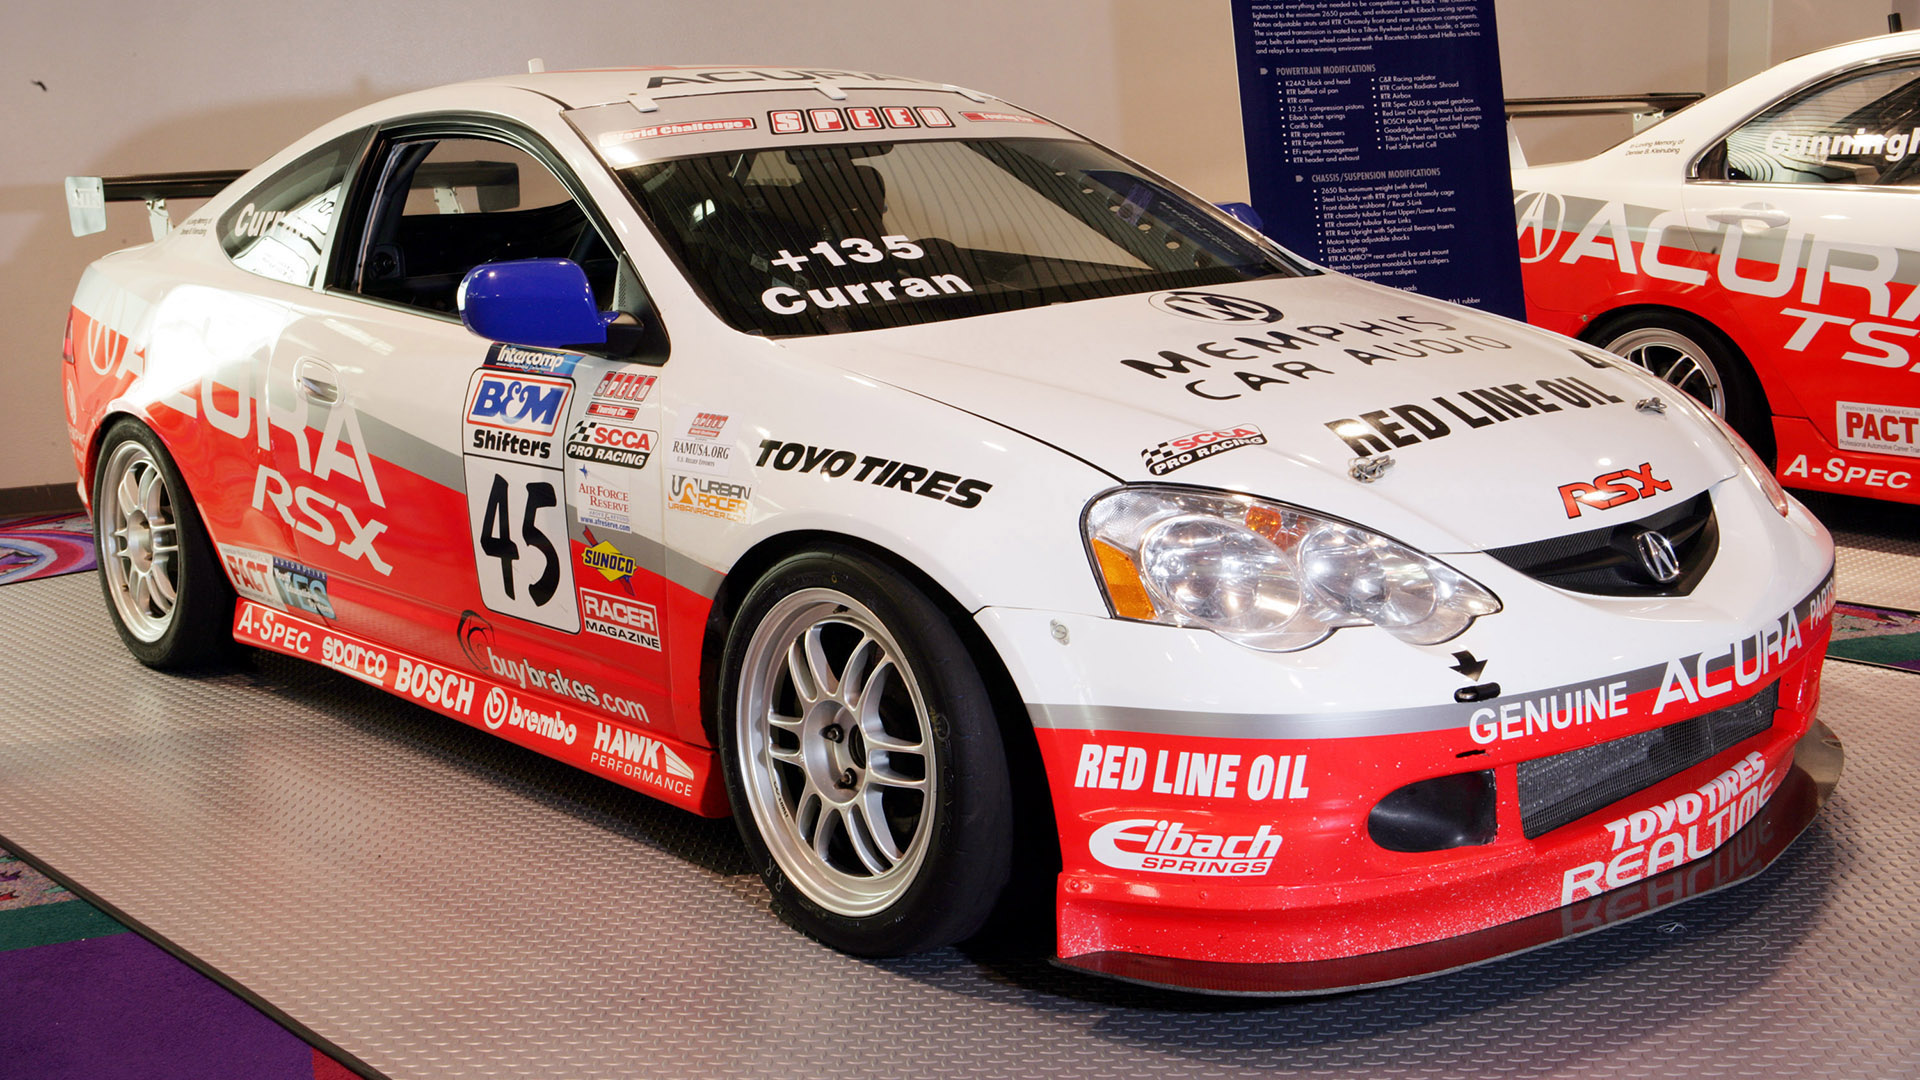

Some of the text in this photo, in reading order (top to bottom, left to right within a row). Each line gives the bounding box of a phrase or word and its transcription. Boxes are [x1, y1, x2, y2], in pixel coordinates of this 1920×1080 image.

[647, 70, 920, 89] ACURA
[1276, 64, 1376, 75] POWERTRAIN MODIFICATIONS
[660, 120, 744, 135] Challenge
[771, 107, 953, 133] SPEED
[1388, 168, 1440, 178] MODIFICATIONS
[1395, 183, 1407, 191] (with
[771, 235, 924, 272] +135
[1346, 237, 1360, 245] triple
[761, 273, 973, 315] Curran
[497, 344, 564, 372] Intercomp
[1120, 316, 1456, 379] MEMPHIS
[1779, 307, 1920, 373] TS
[1185, 335, 1512, 400] CAR AUDIO
[472, 380, 565, 425] B&M
[595, 375, 654, 402] SPEED
[1324, 376, 1625, 457] RED LINE OIL
[1846, 411, 1919, 444] PACT
[473, 429, 551, 459] Shifters
[568, 444, 646, 466] PRO RACING
[594, 427, 650, 451] SCCA
[673, 441, 730, 459] RAMUSA.ORG
[1154, 436, 1264, 475] PRO RACING
[1172, 428, 1257, 451] SCCA
[699, 478, 751, 499] URBAN
[755, 439, 993, 509] TOYO TIRES
[1557, 462, 1673, 519] RSX
[251, 464, 394, 577] RSX
[698, 493, 748, 514] RACER
[480, 473, 560, 607] 45
[275, 558, 327, 580] AUTOMOTIVE
[584, 550, 635, 574] SUNOCO
[237, 610, 311, 653] A-SPEC
[584, 595, 655, 632] RACER
[585, 620, 660, 649] MAGAZINE
[321, 635, 387, 682] sparco
[1469, 681, 1628, 744] GENUINE
[1652, 608, 1802, 715] ACURA
[394, 659, 475, 715] BOSCH
[487, 646, 650, 724] buybrakes.com
[508, 697, 577, 745] brembo
[593, 722, 661, 769] HAWK
[591, 752, 693, 797] PERFORMANCE
[1074, 744, 1309, 801] RED LINE OIL
[1603, 751, 1766, 851] TOYO TIRES
[1089, 819, 1283, 866] Eibach
[1561, 769, 1776, 906] REALTIME
[1141, 857, 1267, 874] SPRINGS
